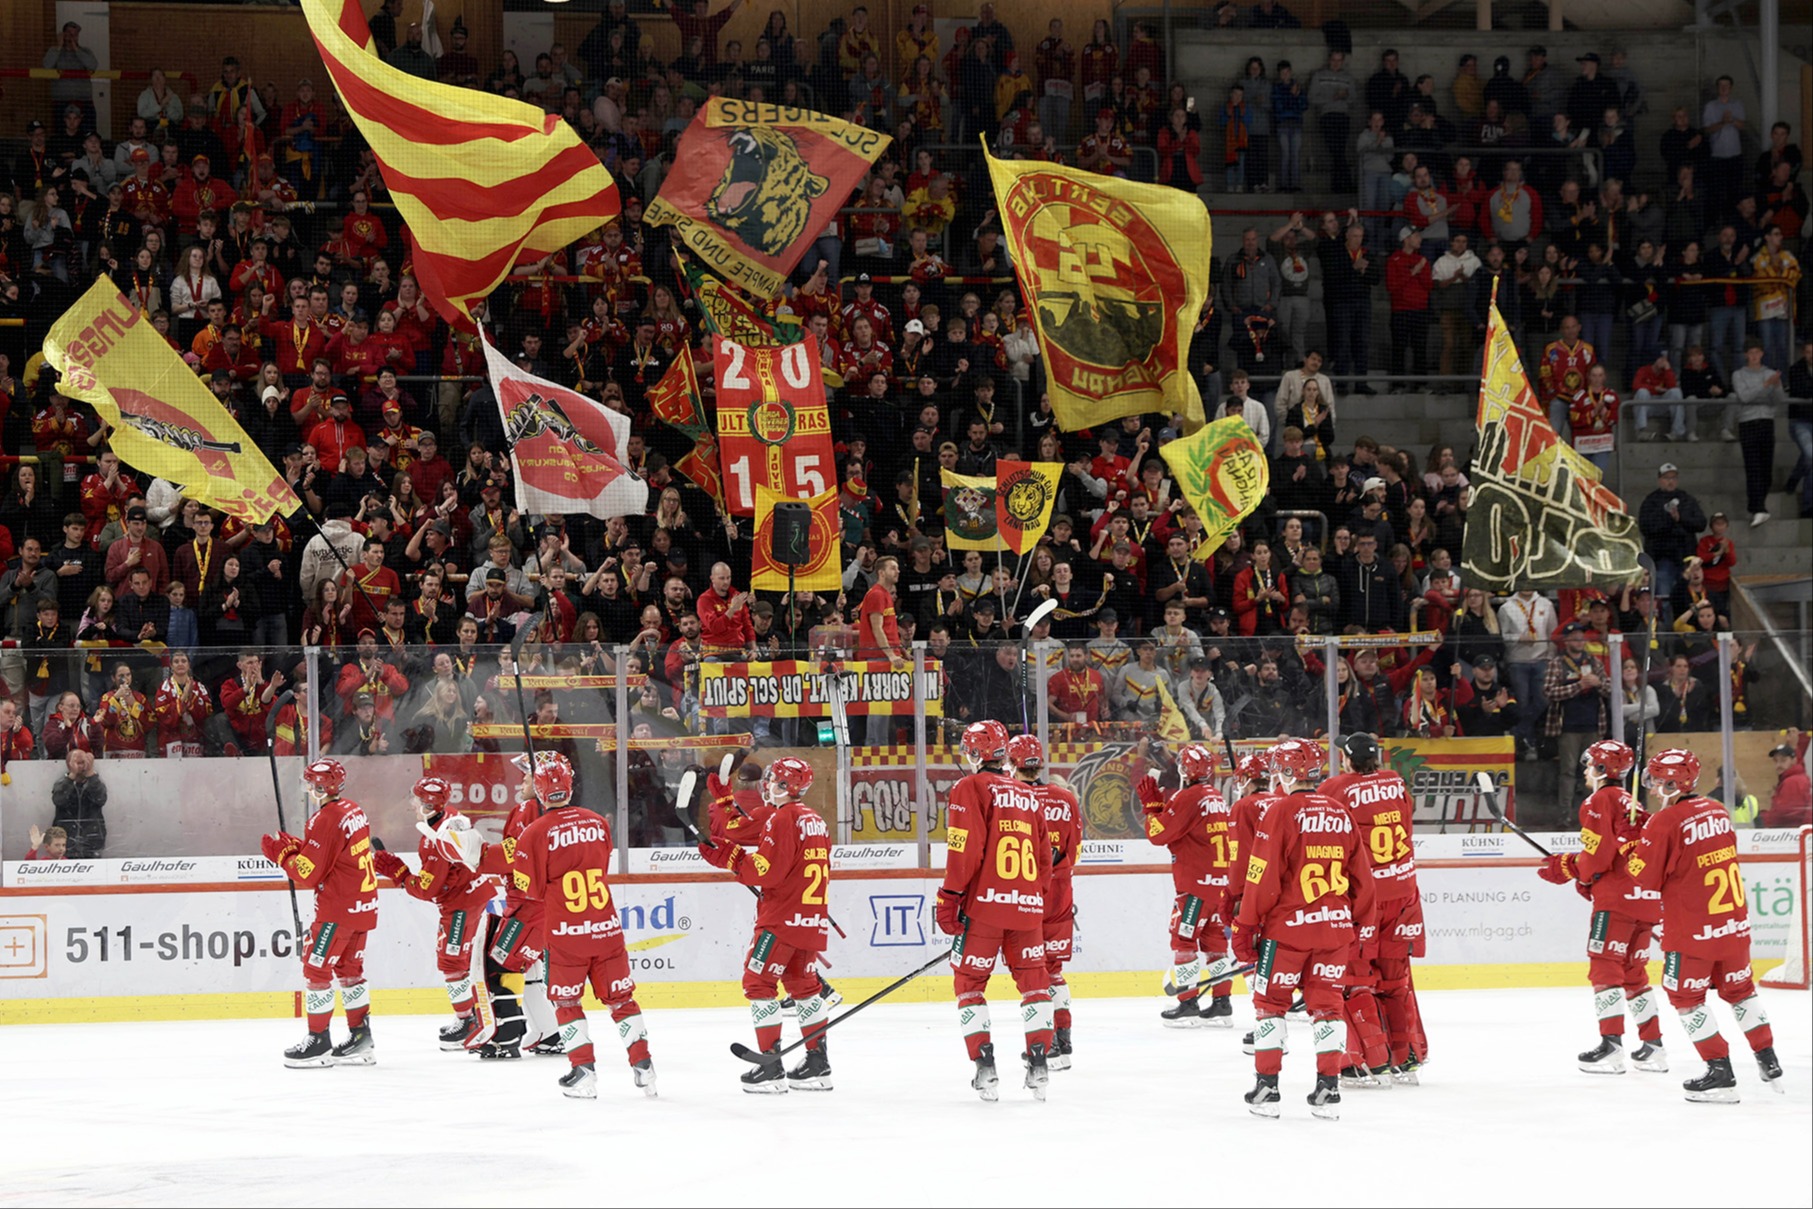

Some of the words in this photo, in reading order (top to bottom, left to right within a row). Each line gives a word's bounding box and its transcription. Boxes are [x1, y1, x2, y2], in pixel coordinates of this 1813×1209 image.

[750, 64, 776, 74] PARIS
[798, 412, 827, 430] RAS
[1003, 516, 1041, 532] LANGNAU
[704, 676, 748, 706] SPIUT
[753, 675, 779, 704] SCL
[782, 674, 802, 703] DR
[862, 672, 910, 700] SORRY
[992, 787, 1040, 813] Jakob
[1373, 810, 1402, 826] MEYER
[1751, 832, 1800, 844] Gaulho
[650, 850, 704, 862] Gaulho
[833, 846, 905, 859] Gaulhofer
[996, 835, 1038, 882] 66
[1306, 846, 1344, 859] WAGNER
[17, 862, 95, 876] Gaulhofer
[120, 860, 197, 873] Gaulhofer
[562, 868, 610, 914] 95
[1300, 861, 1350, 904] 64
[1704, 863, 1744, 915] 20
[976, 888, 1044, 907] Jakob
[1443, 891, 1507, 903] PLANUNG
[1512, 890, 1532, 903] AG
[552, 914, 620, 936] Jakob
[885, 905, 916, 936] IT
[1429, 921, 1533, 941] www.mlg-ag.ch
[630, 958, 676, 970] TOOL
[475, 980, 492, 1026] VAUGHN
